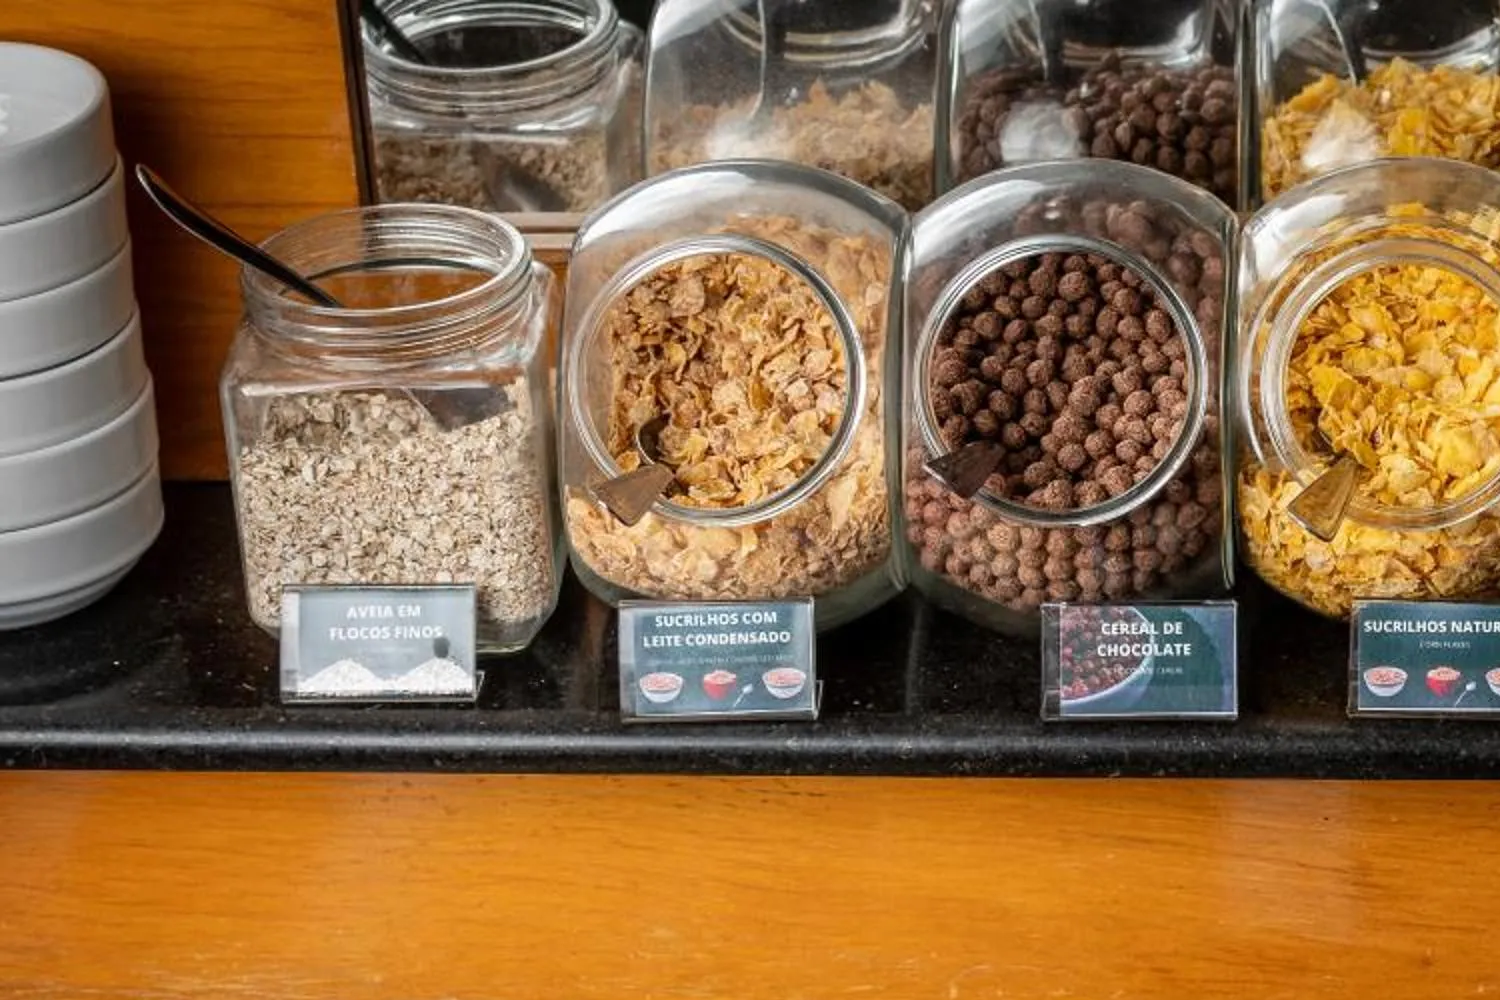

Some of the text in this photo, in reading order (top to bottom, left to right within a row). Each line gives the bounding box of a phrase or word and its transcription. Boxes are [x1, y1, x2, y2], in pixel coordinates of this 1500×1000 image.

[346, 605, 421, 619] AVEIA EM
[655, 611, 777, 628] SUCRILHOS COM
[1363, 620, 1447, 633] SUCRILHOS
[329, 626, 443, 641] FLOCOS FINOS
[1101, 622, 1183, 635] CEREAL DE
[643, 631, 791, 648] LEITE CONDENSADO
[1097, 643, 1192, 657] CHOCOLATE
